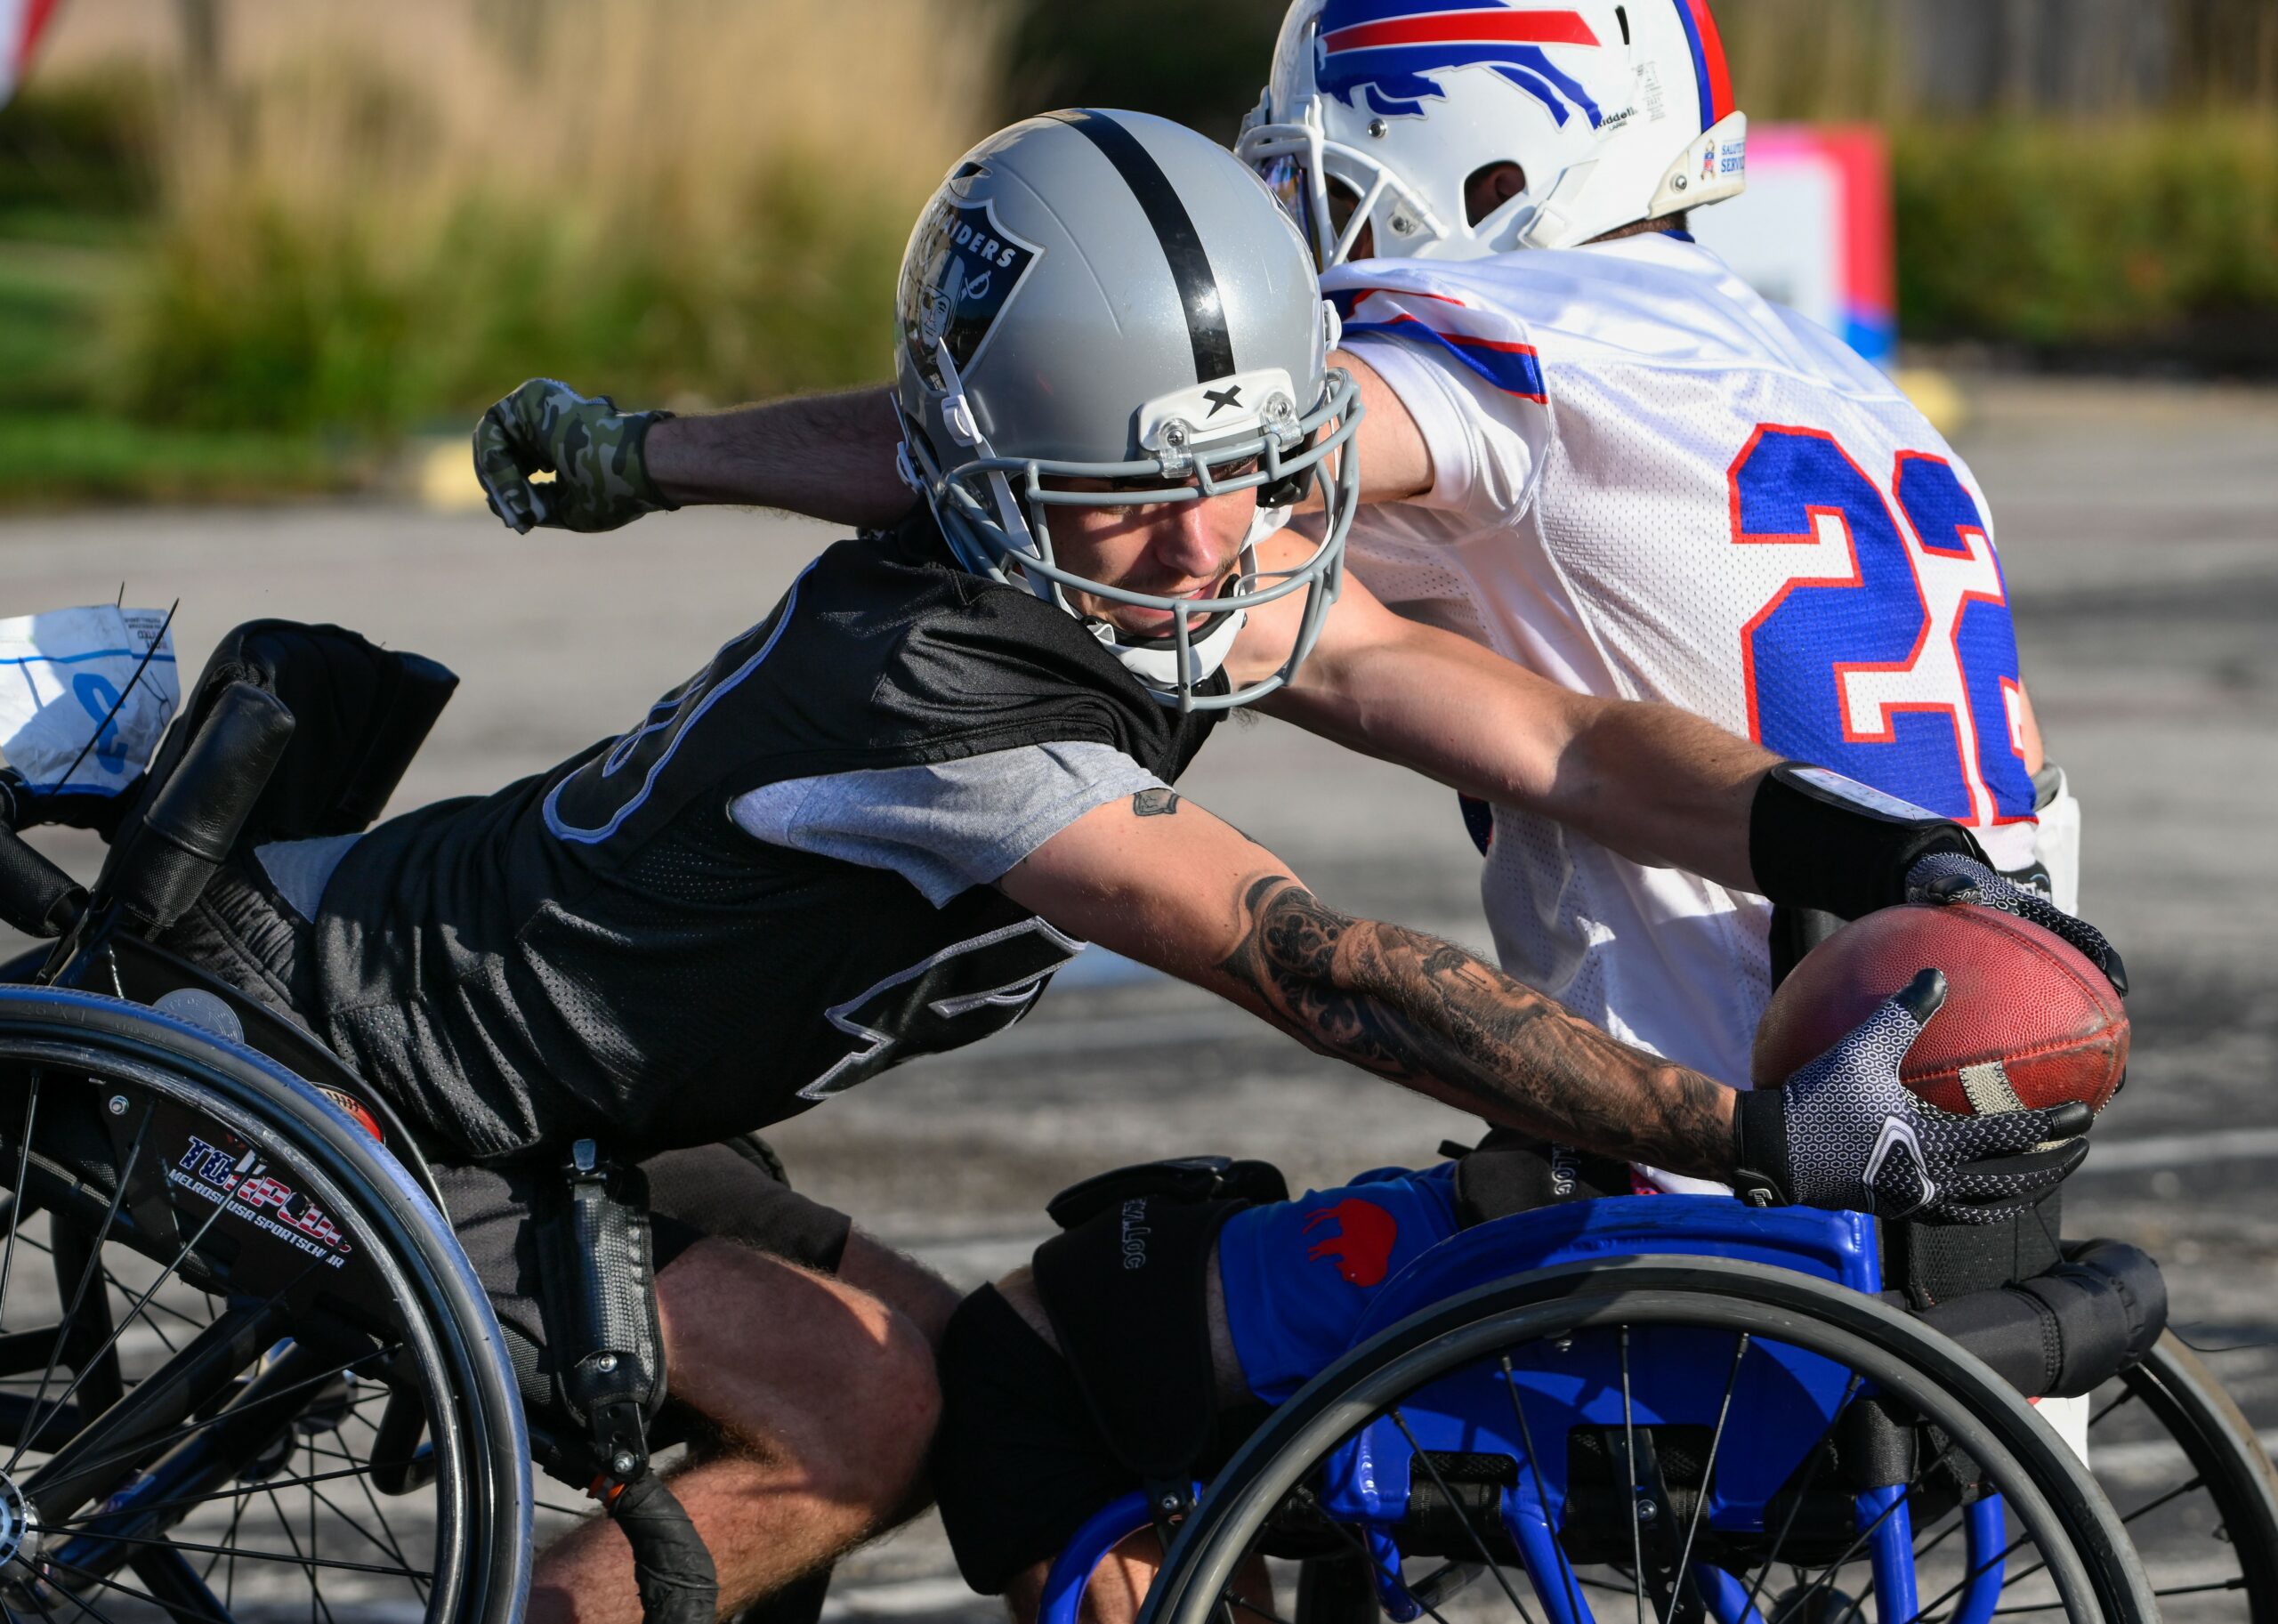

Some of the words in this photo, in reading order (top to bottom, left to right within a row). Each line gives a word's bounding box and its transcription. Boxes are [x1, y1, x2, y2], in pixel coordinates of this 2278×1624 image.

[1597, 107, 1635, 127] iddell
[1727, 423, 2040, 827] 22
[168, 1168, 226, 1205] MELROS
[226, 1199, 256, 1221] USA
[254, 1214, 345, 1269] SPORTSCHIR
